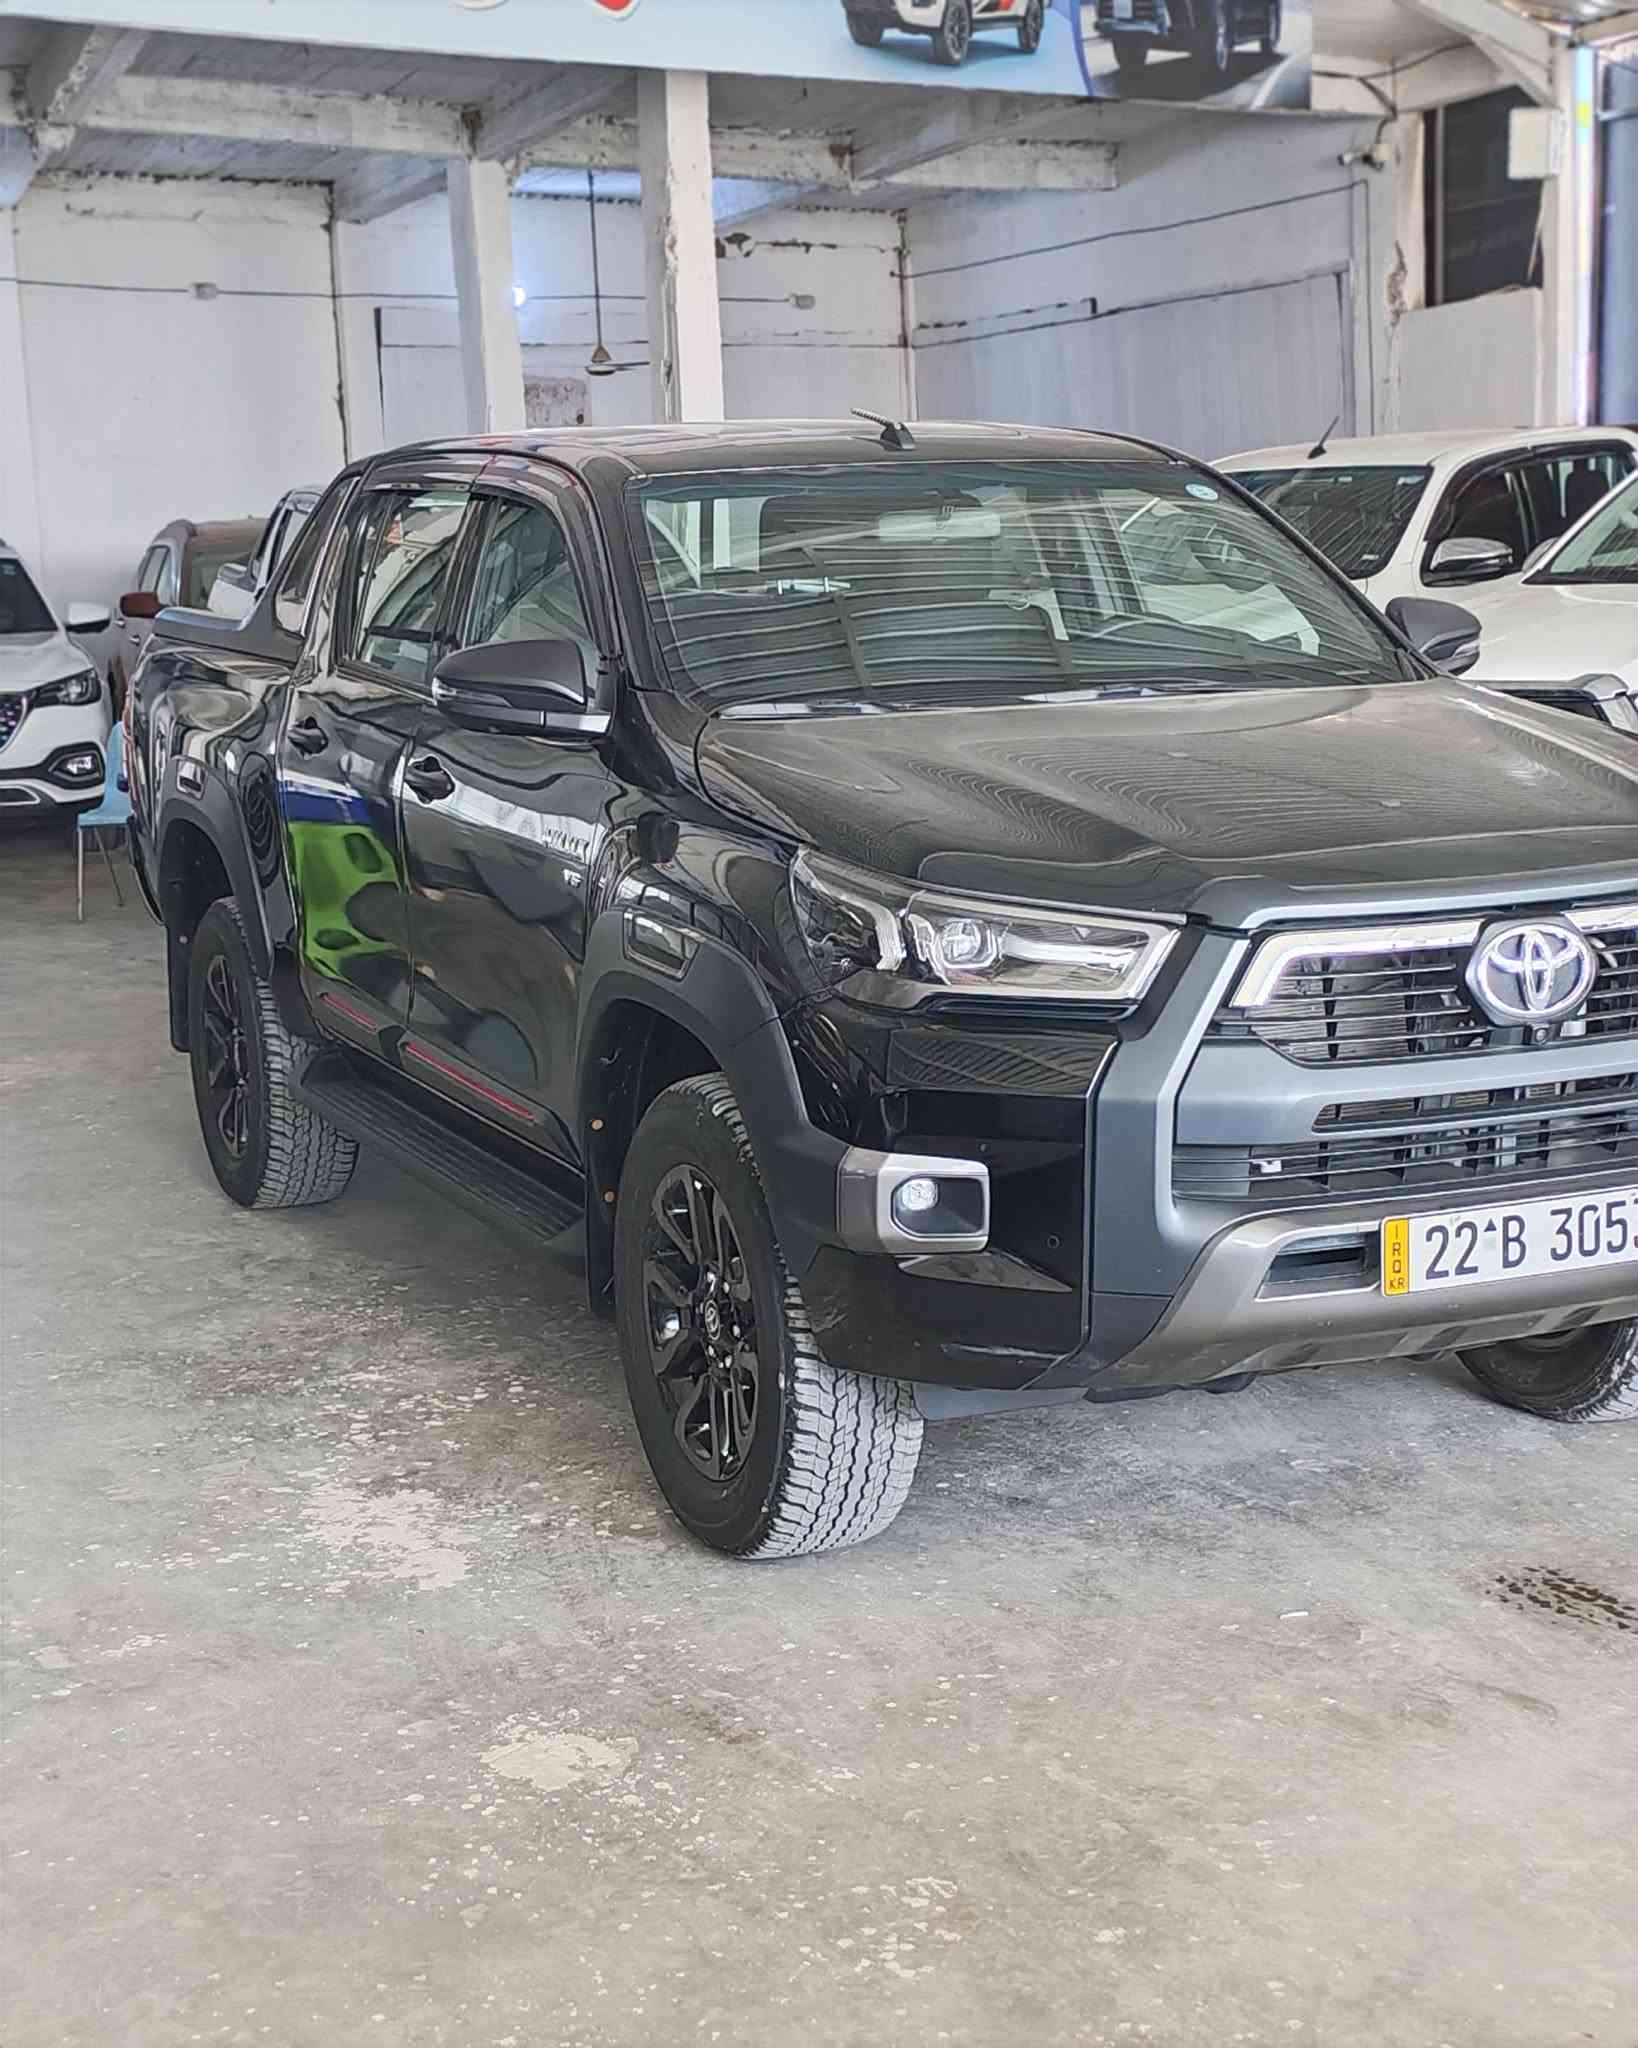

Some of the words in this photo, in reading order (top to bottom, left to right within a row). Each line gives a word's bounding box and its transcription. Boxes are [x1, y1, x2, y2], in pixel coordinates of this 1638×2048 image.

[1425, 1221, 1479, 1280] 22
[1502, 1215, 1526, 1269] B
[1550, 1199, 1638, 1261] 305
[1388, 1277, 1405, 1290] KR
